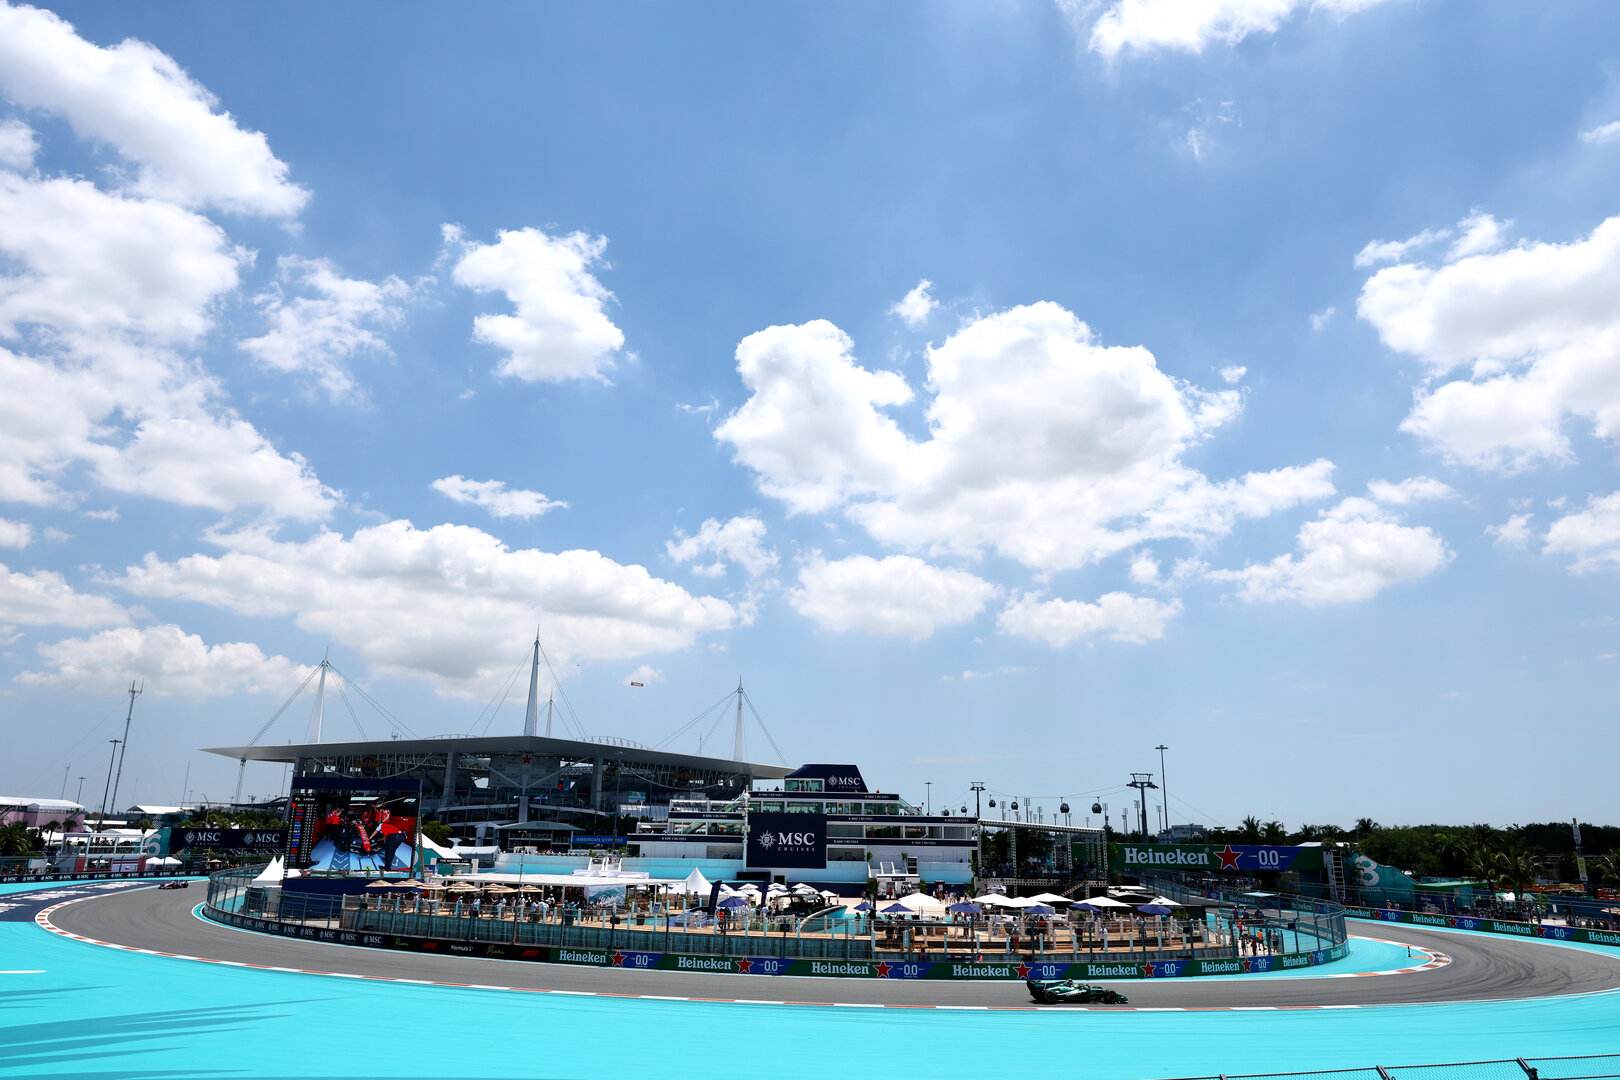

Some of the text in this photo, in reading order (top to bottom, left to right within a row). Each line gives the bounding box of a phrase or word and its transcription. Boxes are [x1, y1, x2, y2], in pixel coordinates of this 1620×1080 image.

[838, 776, 861, 786] MSC
[197, 832, 220, 841] MSC
[256, 834, 280, 843] MSC
[778, 832, 815, 845] MSC
[144, 833, 161, 857] 6
[1124, 848, 1279, 866] Heineken 0.0
[1355, 856, 1380, 886] 8
[1412, 914, 1446, 925] Heineken
[287, 925, 296, 934] MSC
[1493, 922, 1531, 934] Heineken
[324, 931, 335, 939] MSC
[345, 933, 357, 941] MSC
[369, 935, 382, 943] MSC
[1588, 932, 1620, 944] Heinek
[487, 945, 505, 956] Miami
[560, 950, 648, 965] Heineken 0.0
[1283, 954, 1308, 967] Heineken
[678, 956, 778, 972] Heineken 0.0
[811, 962, 918, 976] Heineken 0.0
[1088, 963, 1176, 976] Heineken 0.0
[1201, 961, 1240, 972] Heineken
[952, 965, 1056, 976] Heineken 0.0
